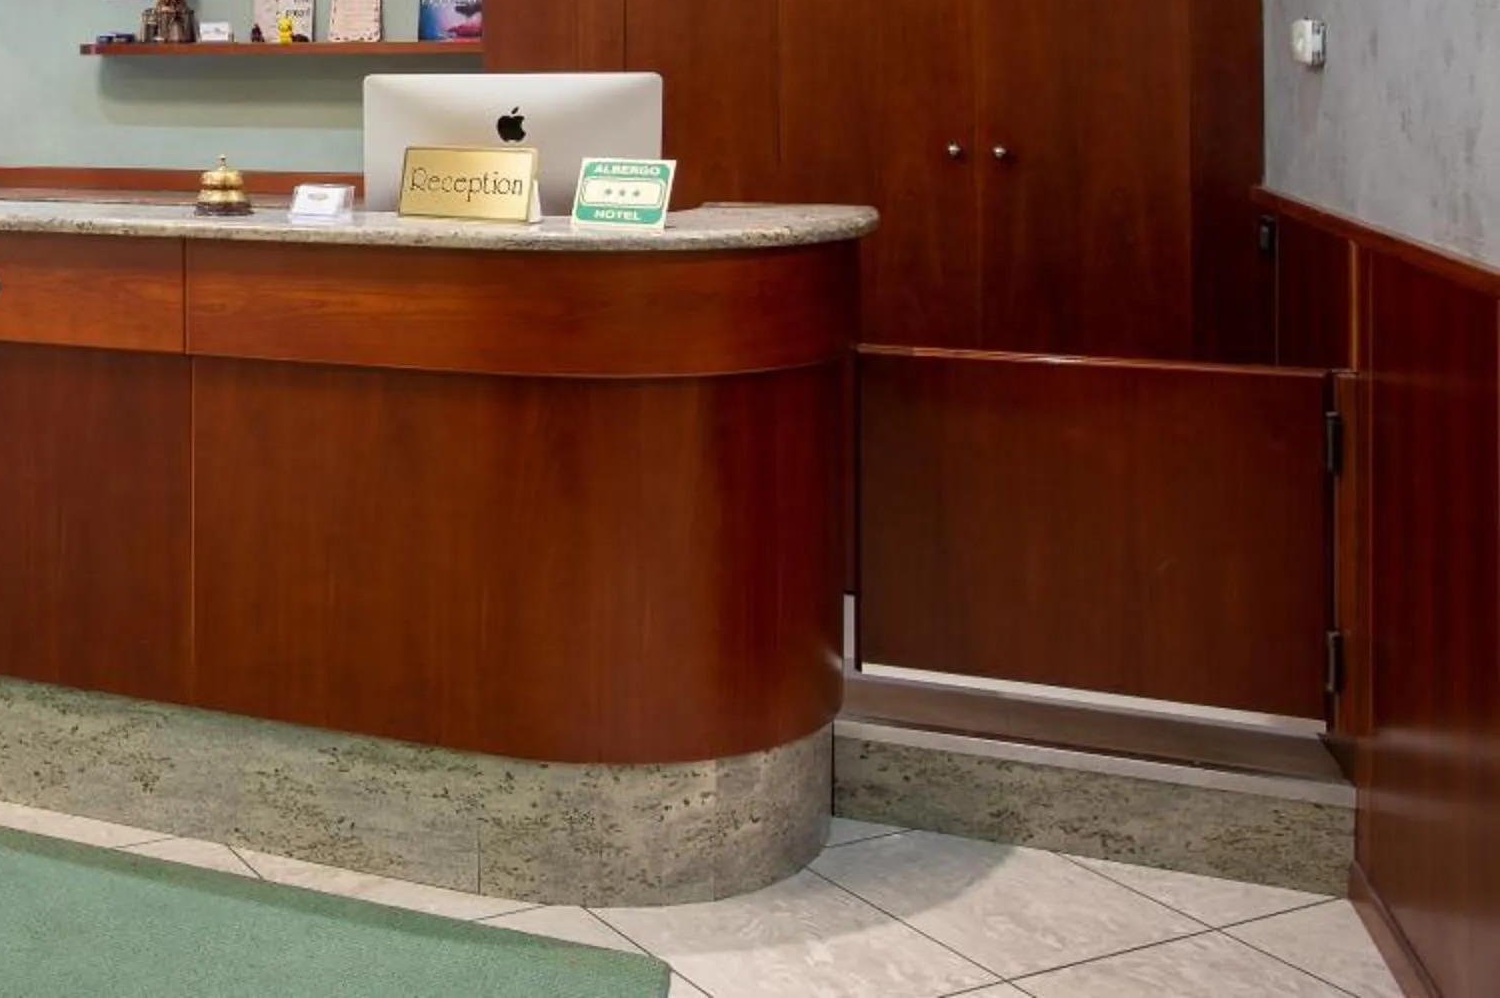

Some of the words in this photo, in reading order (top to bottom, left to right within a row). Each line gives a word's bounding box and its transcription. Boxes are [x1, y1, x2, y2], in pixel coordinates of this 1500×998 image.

[593, 165, 661, 176] ALBERGO
[409, 166, 523, 203] Reception
[593, 209, 642, 221] HOTEL
